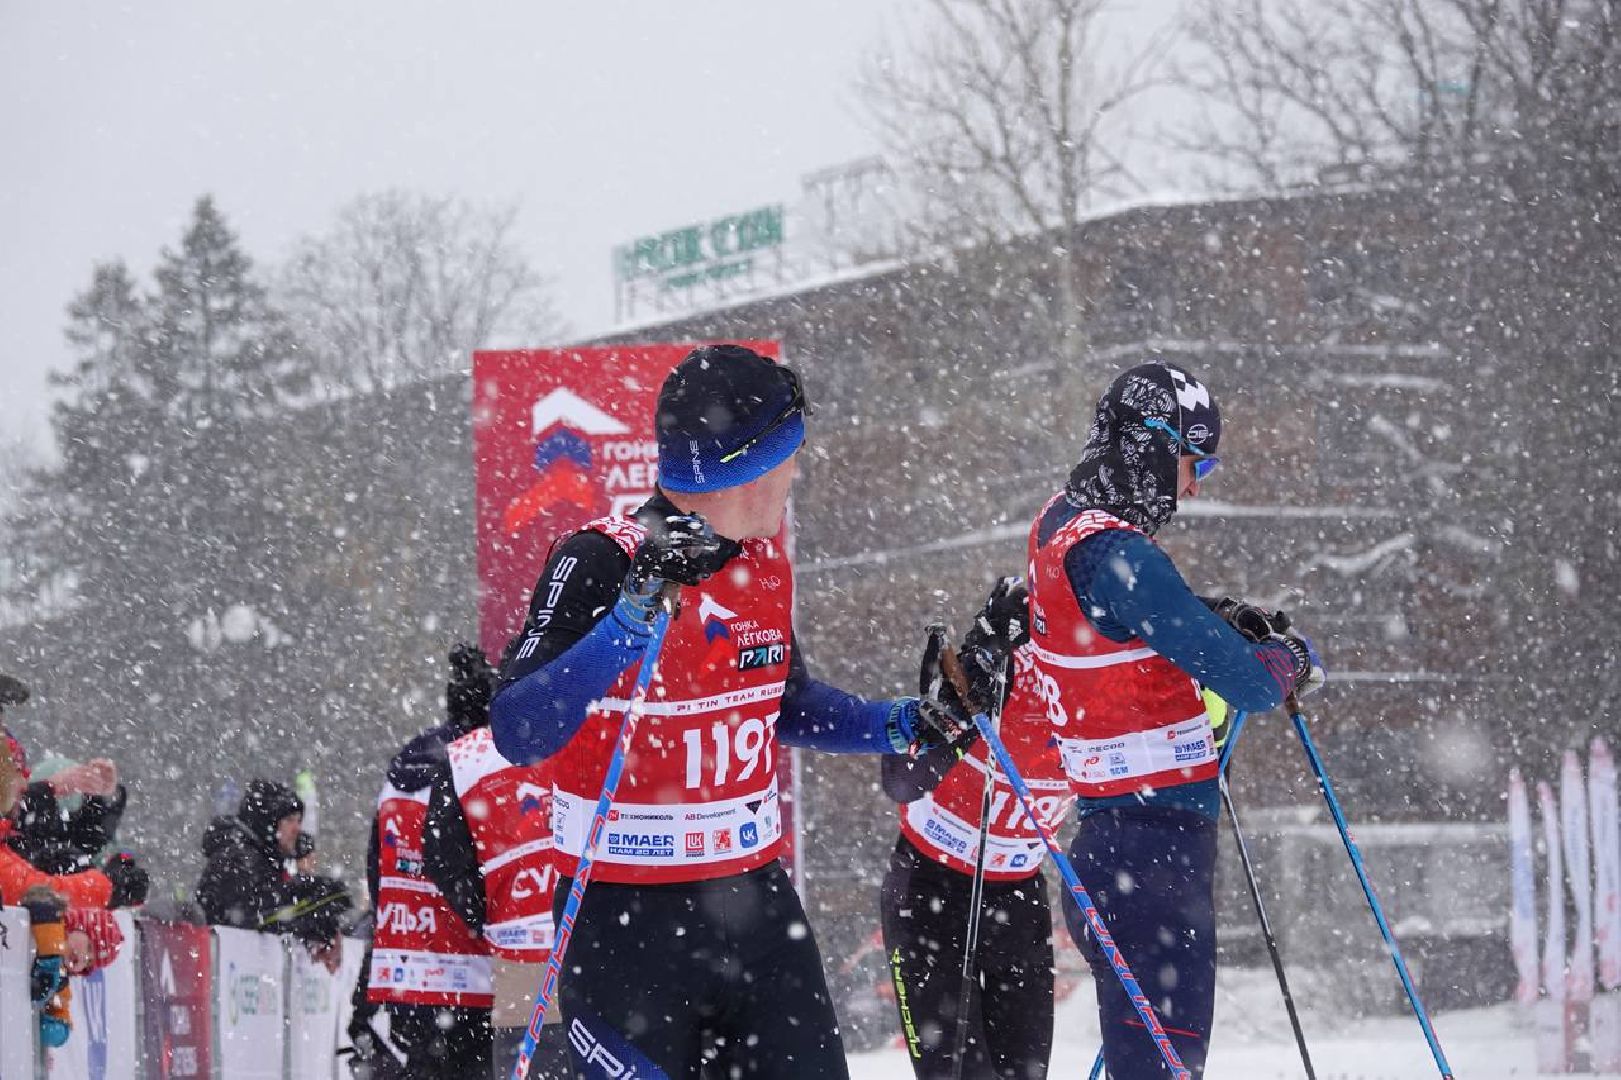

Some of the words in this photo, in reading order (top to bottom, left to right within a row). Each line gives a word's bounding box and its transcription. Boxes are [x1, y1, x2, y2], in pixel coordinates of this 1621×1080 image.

[689, 440, 705, 484] SPINE
[515, 555, 578, 661] SPINE
[725, 690, 755, 704] TEAM
[622, 833, 675, 846] MAER
